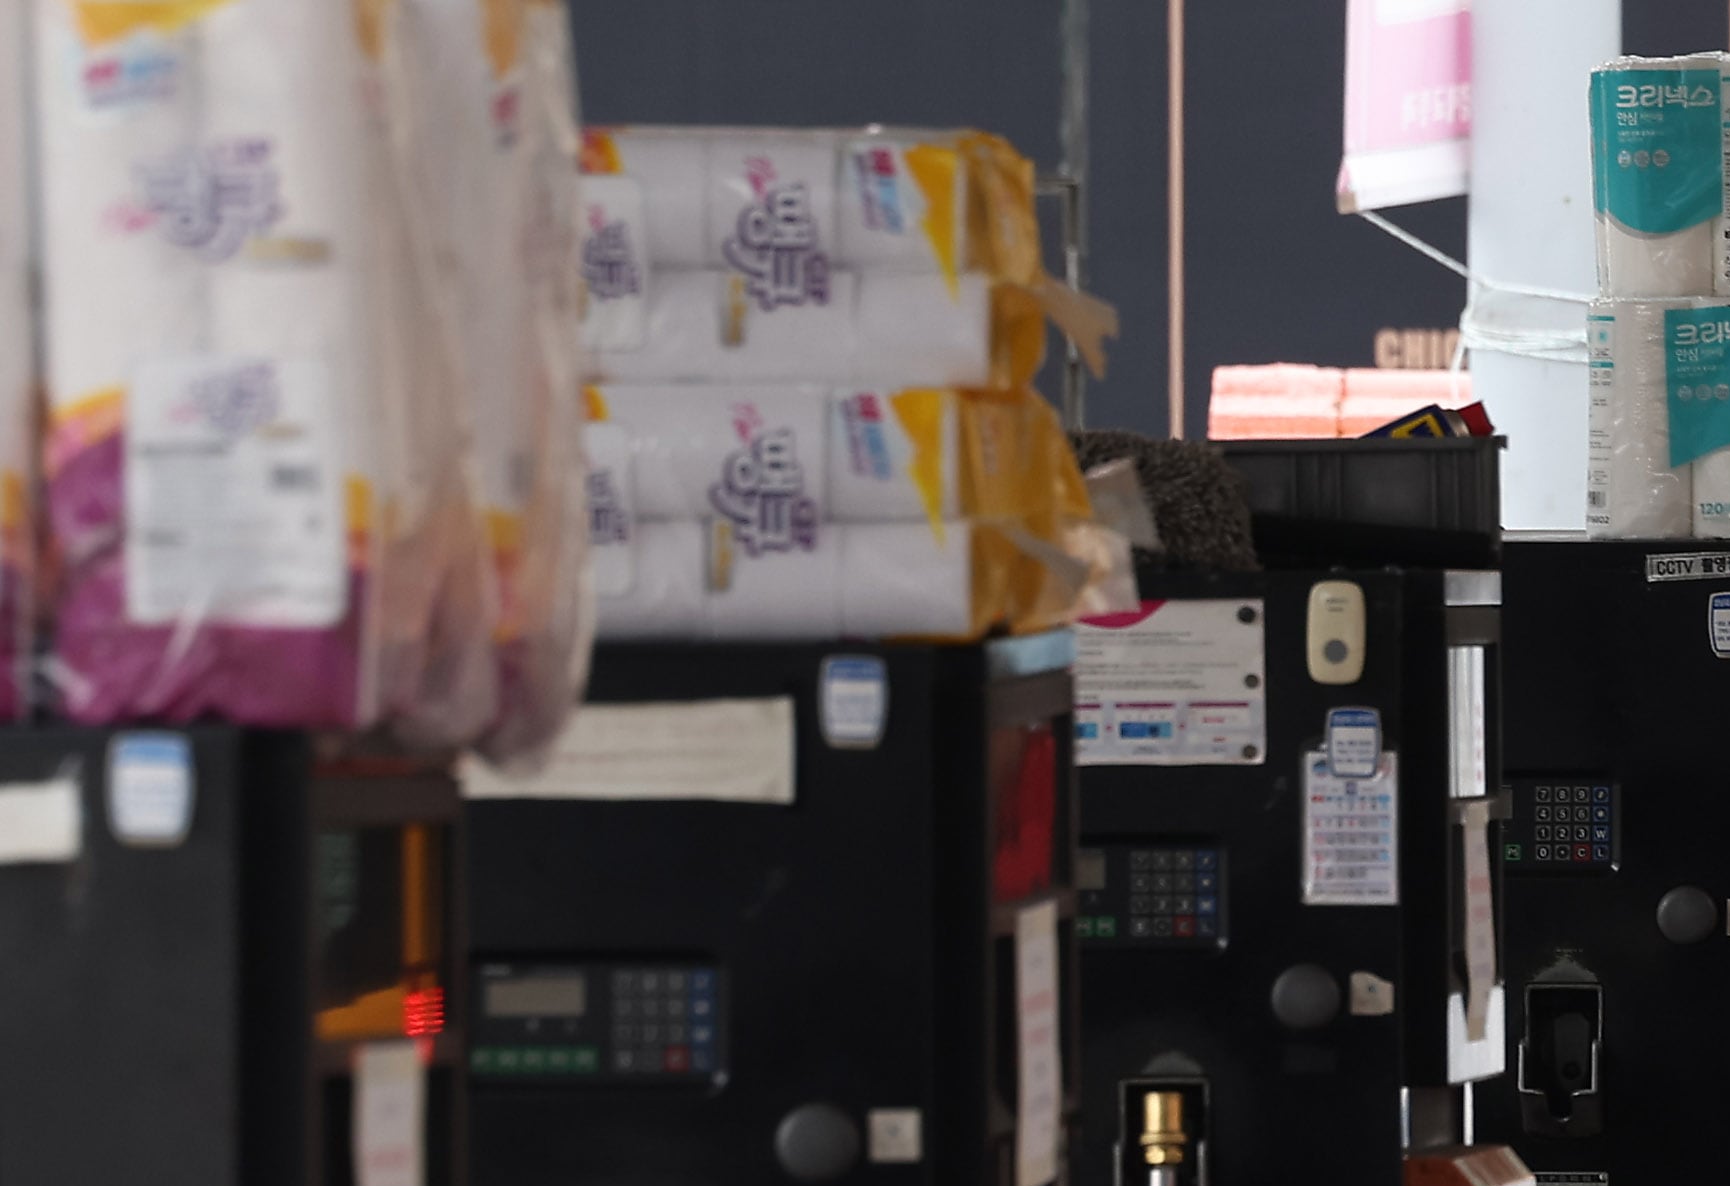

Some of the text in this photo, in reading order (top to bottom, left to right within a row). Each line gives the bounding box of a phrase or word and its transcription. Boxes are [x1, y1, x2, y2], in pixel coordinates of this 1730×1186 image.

[1615, 84, 1715, 109] 크리넥스
[1616, 110, 1639, 126] 안심
[1674, 349, 1699, 363] 안심
[1656, 559, 1694, 576] CCTV
